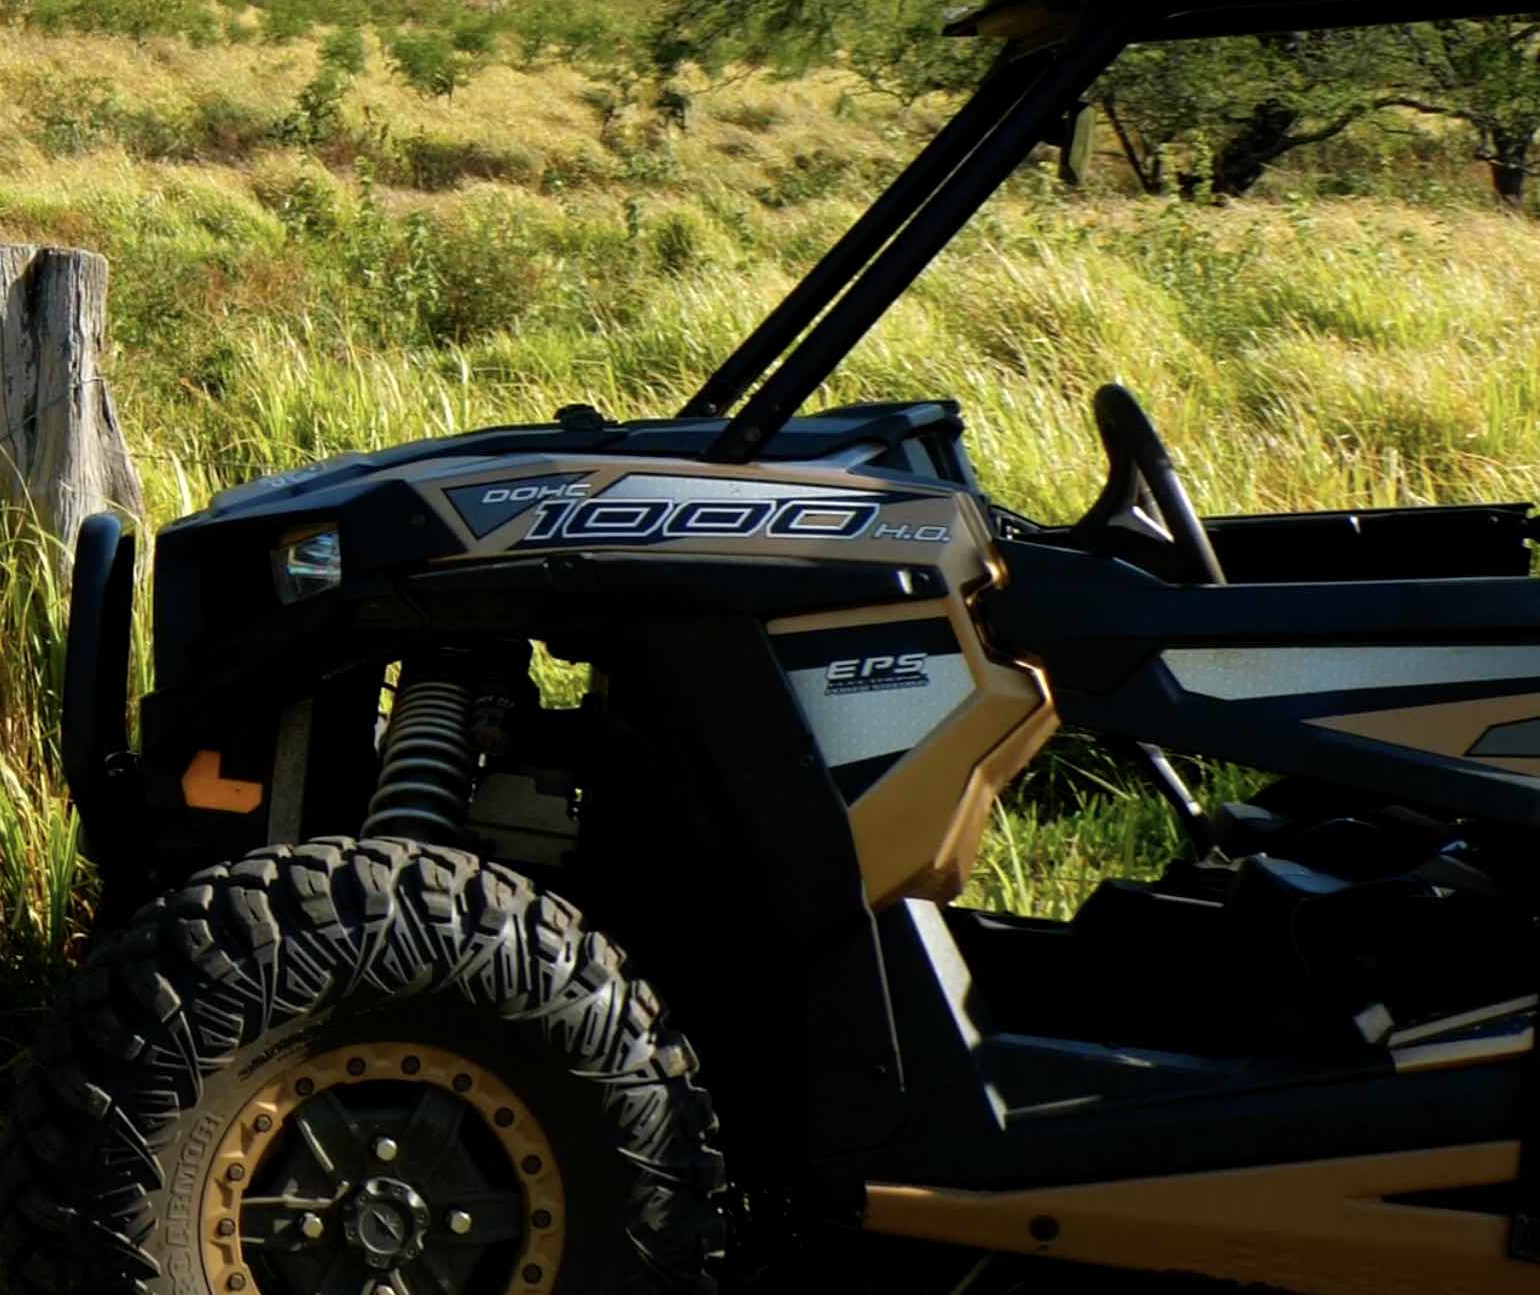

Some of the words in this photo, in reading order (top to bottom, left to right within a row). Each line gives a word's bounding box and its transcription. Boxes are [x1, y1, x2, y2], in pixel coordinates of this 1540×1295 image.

[482, 483, 593, 503] DOHC
[525, 499, 881, 540] 1000
[874, 522, 952, 541] H.O.
[825, 652, 929, 680] EPS
